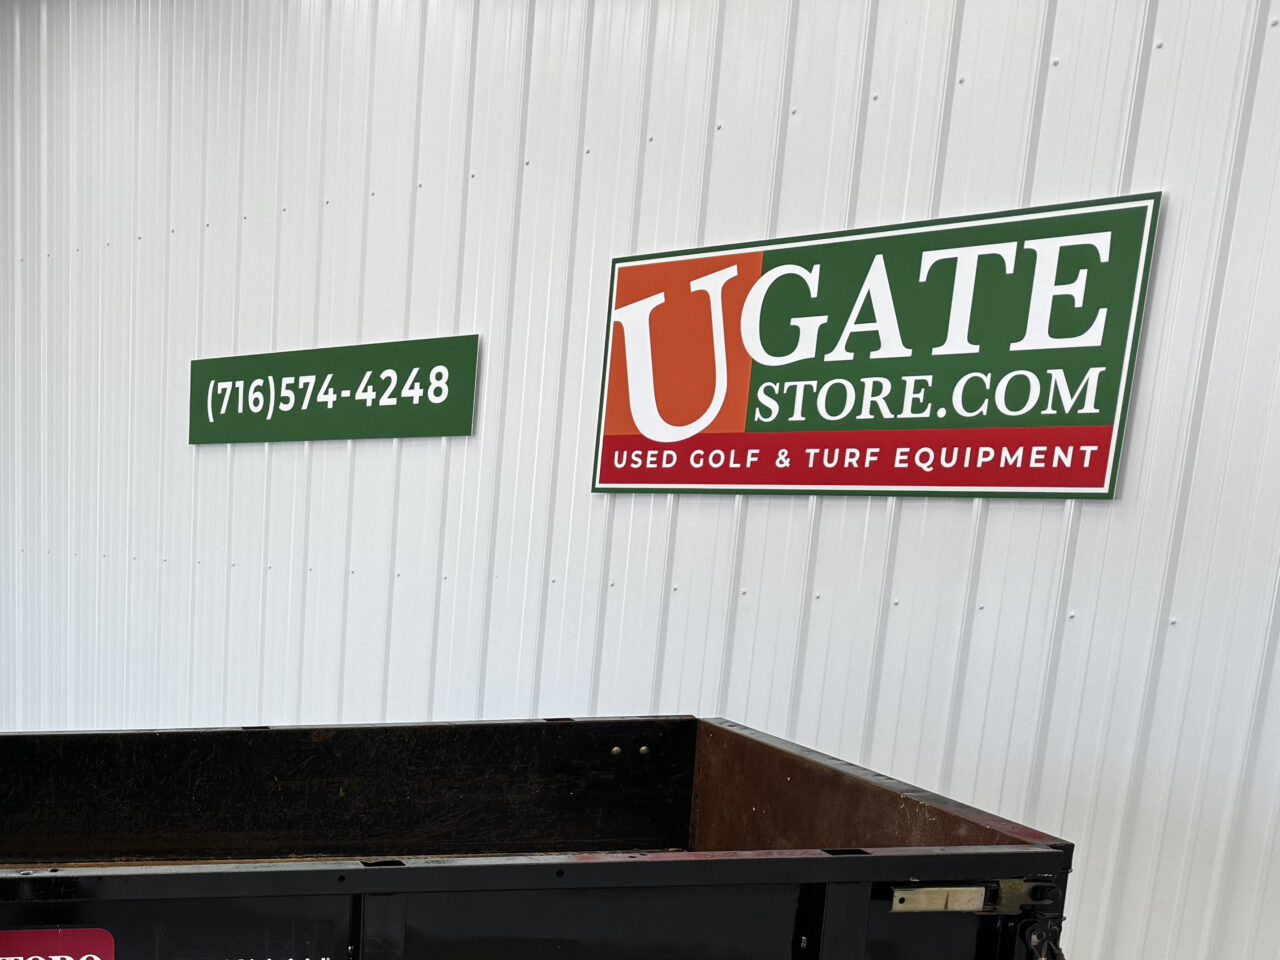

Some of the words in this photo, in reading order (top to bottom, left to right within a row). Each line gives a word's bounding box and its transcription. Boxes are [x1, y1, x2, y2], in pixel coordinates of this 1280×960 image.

[206, 365, 449, 423] (716)574-4248
[753, 366, 1106, 422] STORE.COM
[613, 450, 678, 469] USED
[689, 449, 760, 468] GOLF
[775, 448, 791, 468] &
[805, 447, 880, 468] TURF
[893, 446, 1099, 472] EQUIPMENT
